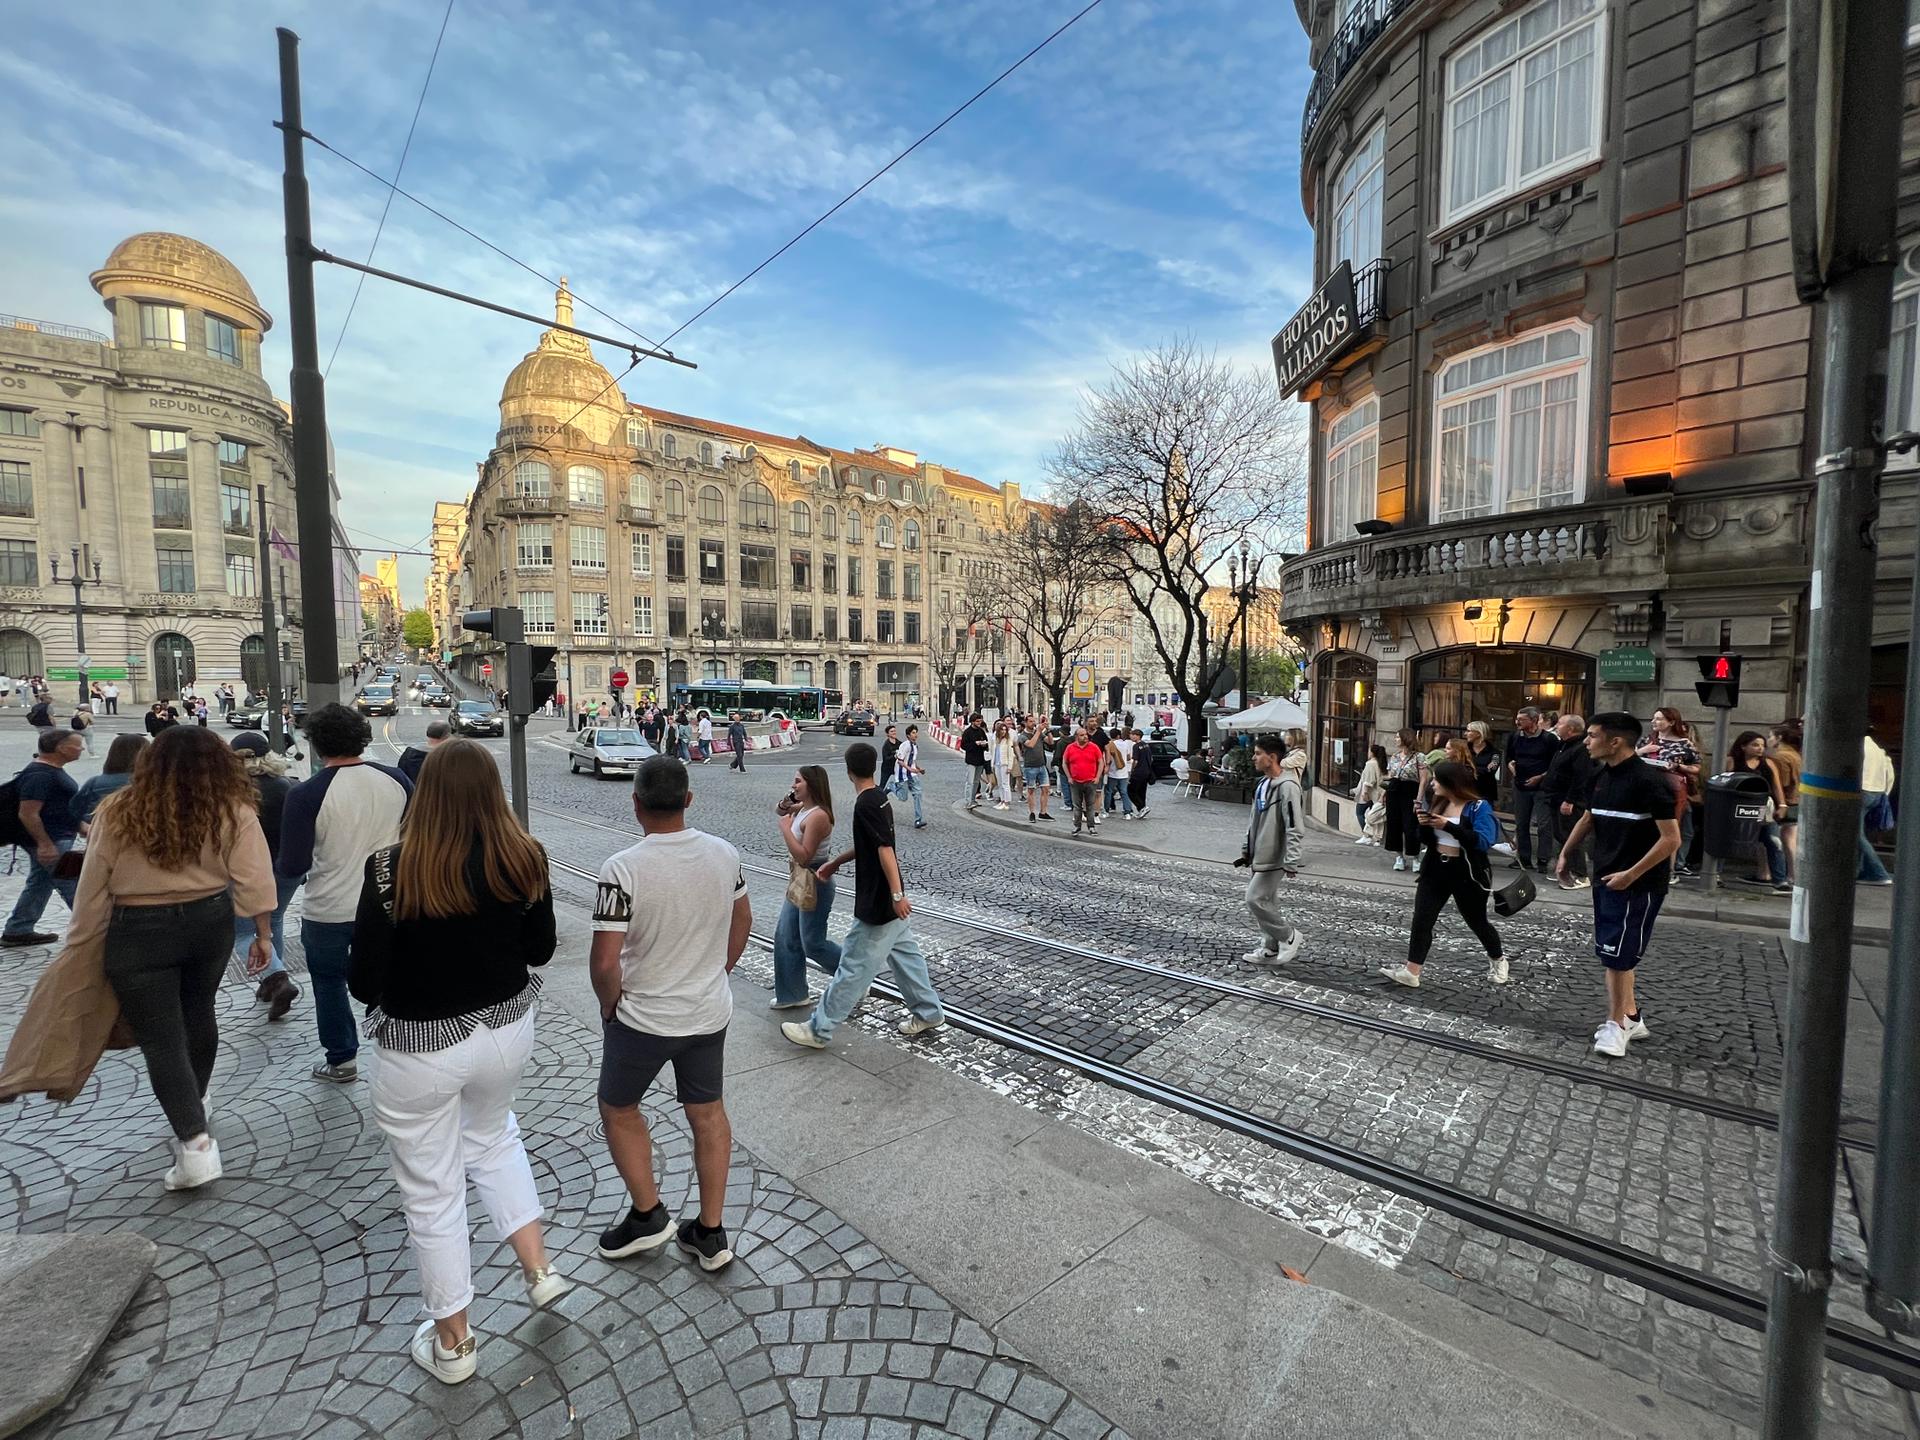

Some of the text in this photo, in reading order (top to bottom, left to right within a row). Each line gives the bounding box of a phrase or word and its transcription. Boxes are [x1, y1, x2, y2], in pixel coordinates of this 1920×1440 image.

[1280, 304, 1349, 387] ALIADOS
[1282, 290, 1330, 354] HOTEL
[150, 398, 232, 421] REPUBLICA
